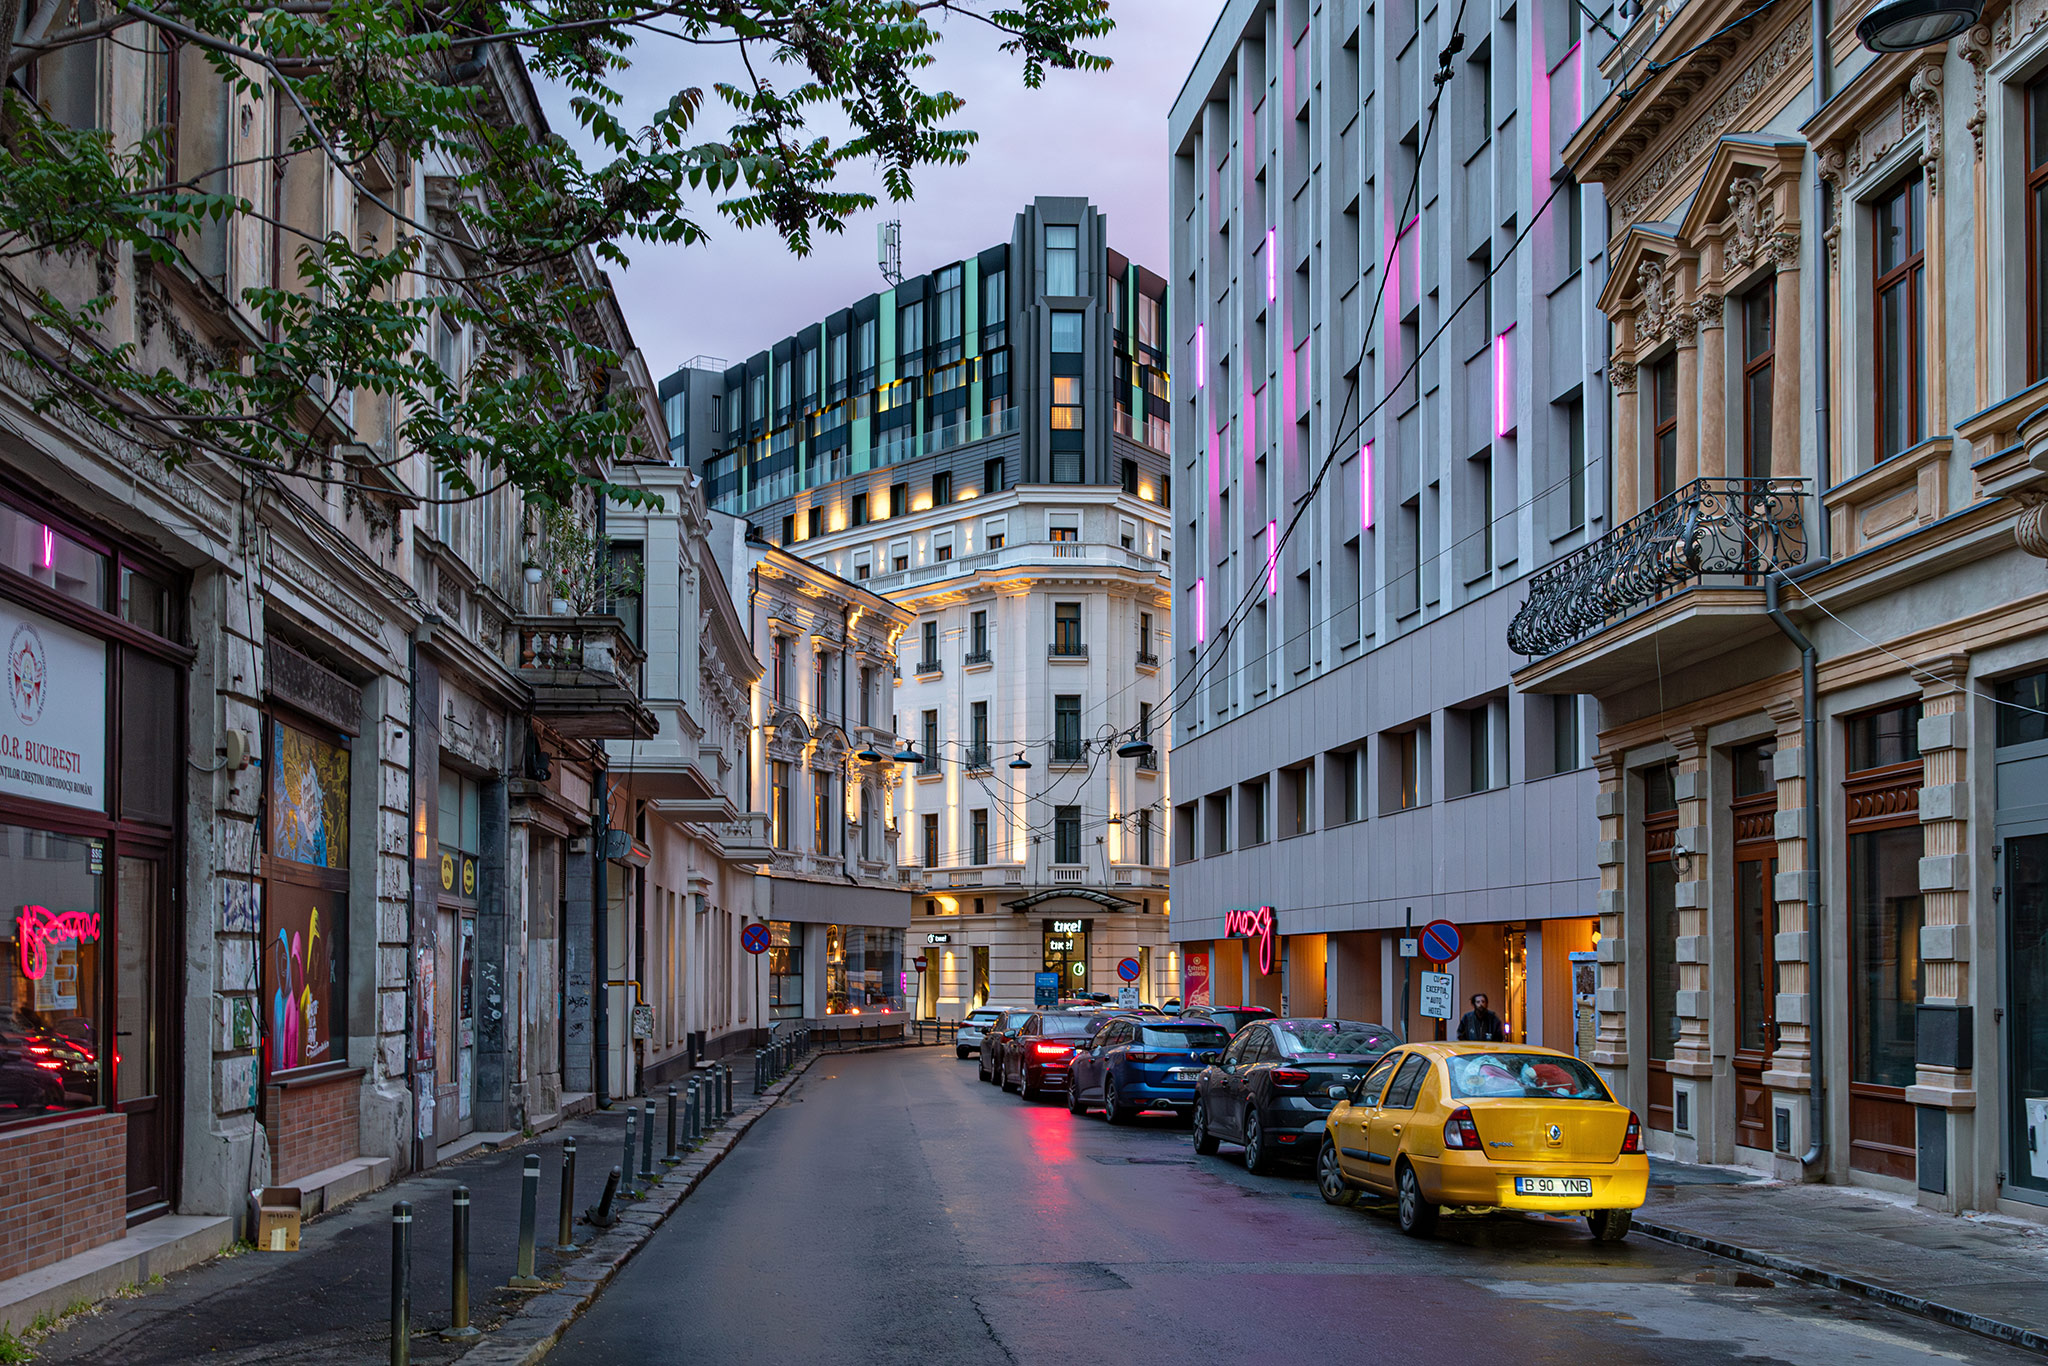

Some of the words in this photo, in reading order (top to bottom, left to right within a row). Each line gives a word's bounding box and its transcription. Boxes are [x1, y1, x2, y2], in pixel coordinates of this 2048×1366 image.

[1224, 906, 1272, 976] moxy
[1428, 1007, 1442, 1016] HOTEL
[1525, 1179, 1534, 1191] B
[1539, 1180, 1554, 1191] 90
[1561, 1181, 1588, 1192] YNB
